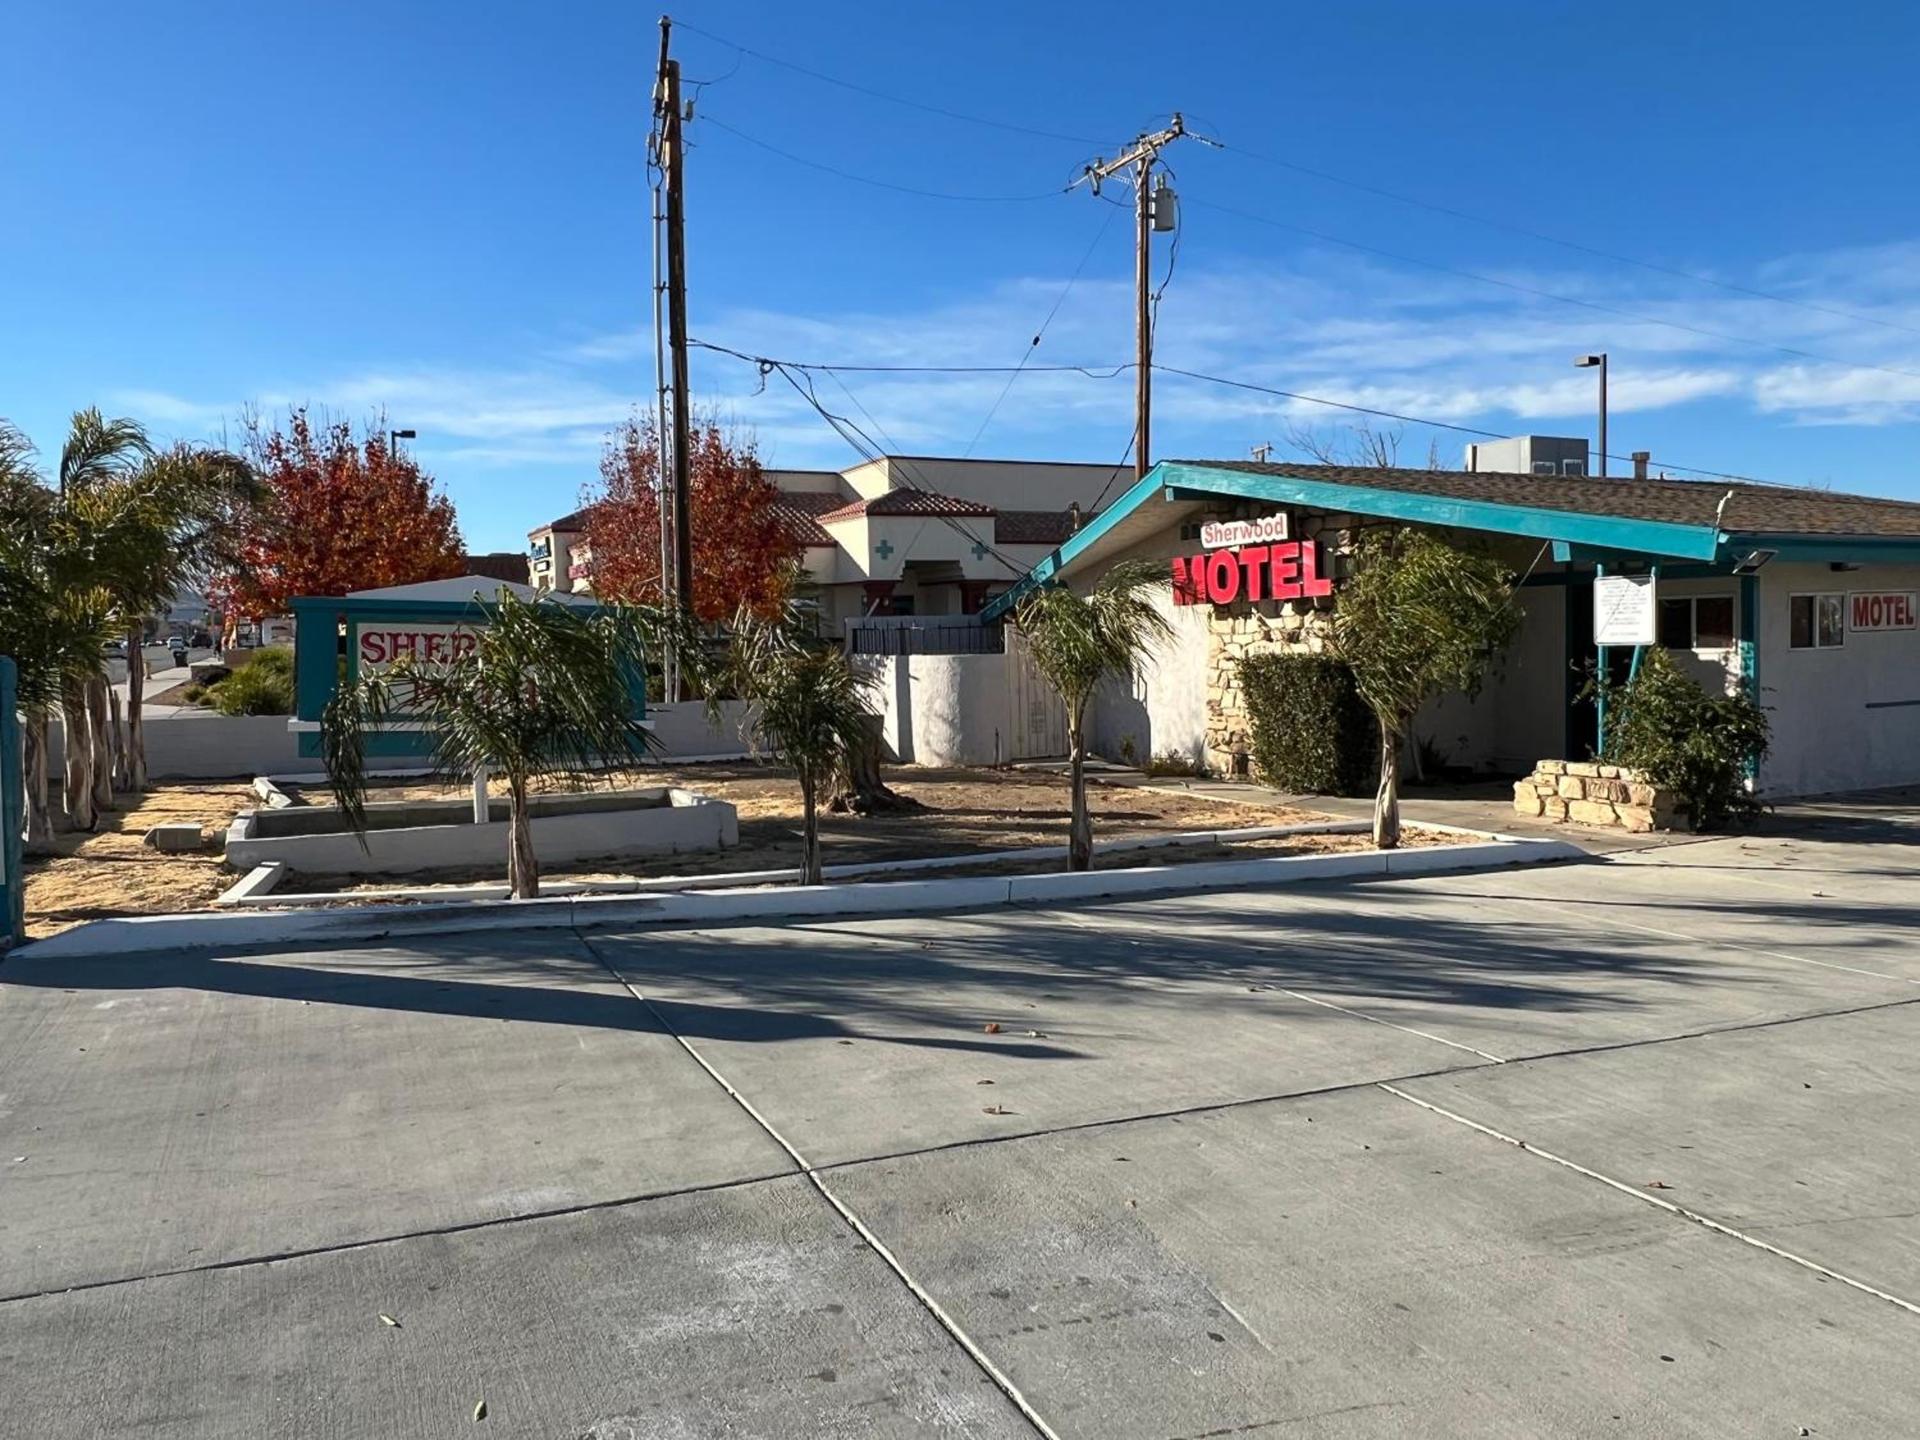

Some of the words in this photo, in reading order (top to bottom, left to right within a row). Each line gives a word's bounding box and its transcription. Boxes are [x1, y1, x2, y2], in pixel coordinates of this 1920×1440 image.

[1204, 516, 1285, 544] Sherwood
[1171, 540, 1332, 606] MOTEL
[1853, 594, 1915, 627] MOTEL
[360, 631, 479, 664] SHER
